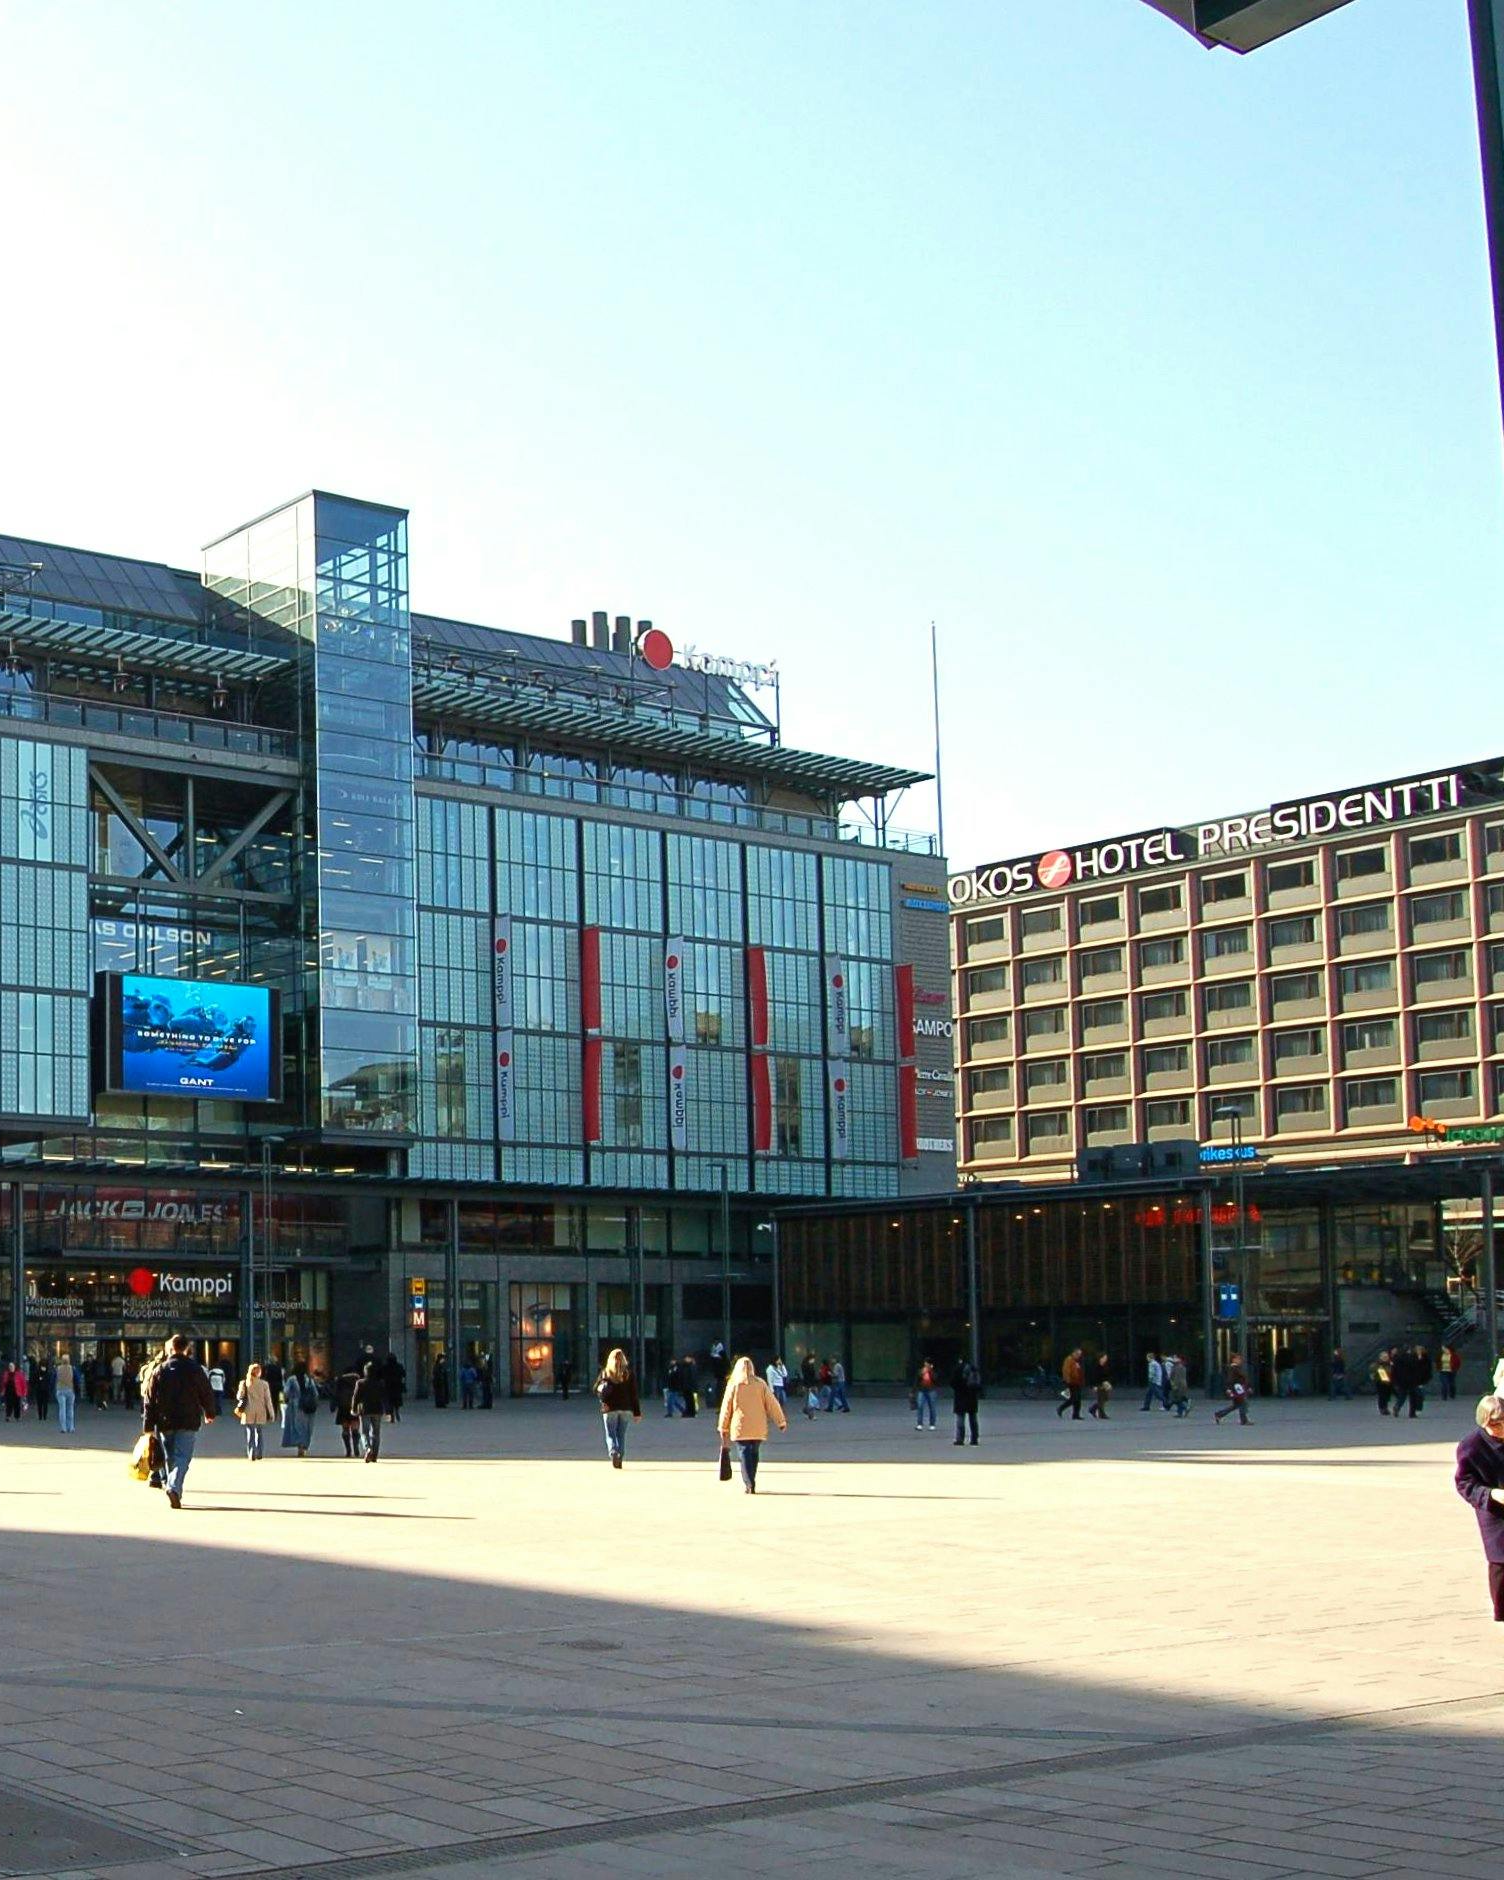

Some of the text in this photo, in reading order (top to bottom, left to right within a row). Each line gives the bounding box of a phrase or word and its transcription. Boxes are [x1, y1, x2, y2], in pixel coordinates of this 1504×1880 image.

[683, 643, 779, 691] Kamppi
[947, 774, 1458, 904] OKOS HOTEL PRESIDENTTI
[137, 1030, 196, 1040] SOMETHING
[179, 1077, 215, 1086] GANT
[1199, 1146, 1257, 1161] rikeskus
[52, 1199, 230, 1224] JACK JONES
[159, 1272, 233, 1298] Kamppi
[413, 1312, 425, 1326] M
